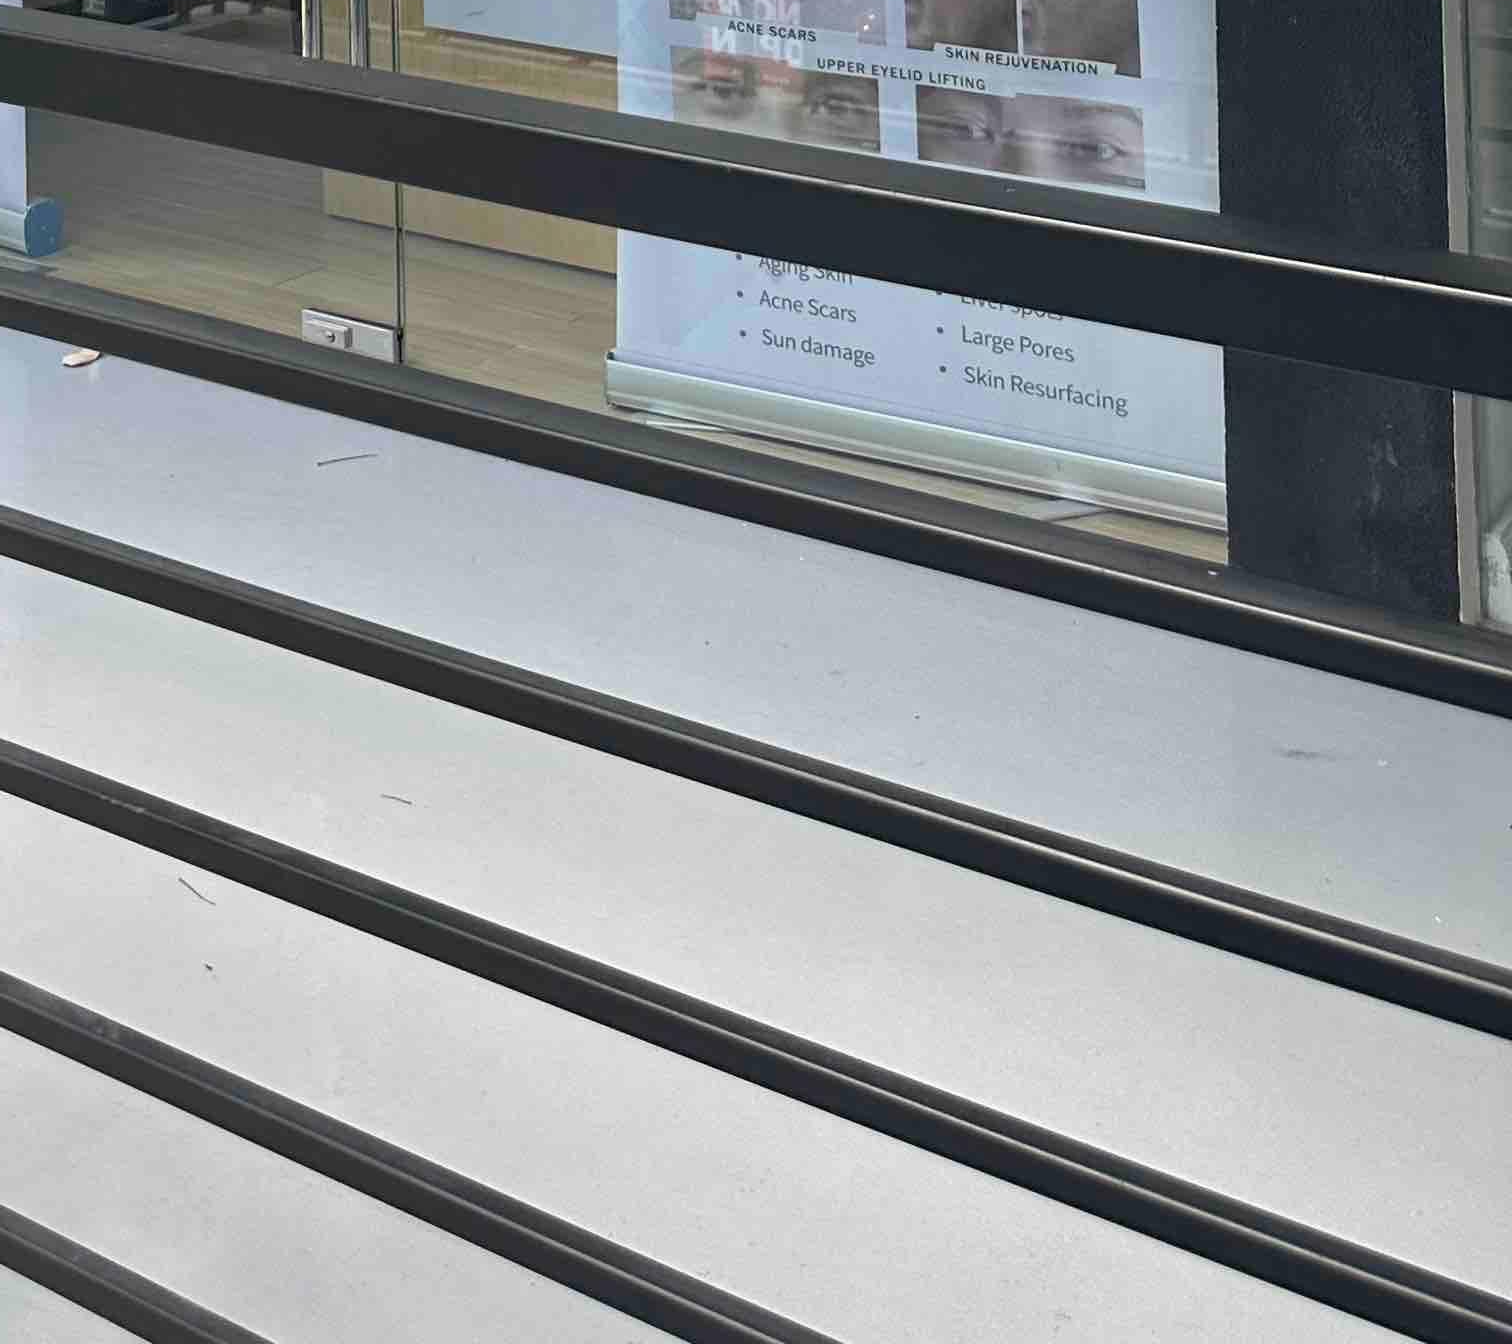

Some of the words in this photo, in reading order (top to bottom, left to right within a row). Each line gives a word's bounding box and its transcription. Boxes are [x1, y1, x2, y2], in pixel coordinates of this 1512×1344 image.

[727, 20, 762, 37] ACNE
[768, 25, 817, 43] SCARS
[816, 57, 866, 76] UPPER
[871, 63, 923, 83] EYELID
[928, 71, 986, 91] LIFTING
[944, 46, 980, 64] SKIN
[985, 51, 1098, 76] REJUVENATION
[759, 288, 804, 313] Acne
[807, 298, 857, 324] Scars
[761, 327, 796, 351] Sun
[800, 335, 876, 368] damage
[961, 324, 1015, 354] Large
[1019, 335, 1076, 363] Pores
[963, 365, 1006, 391] Skin
[1010, 374, 1129, 418] Resurfacing
